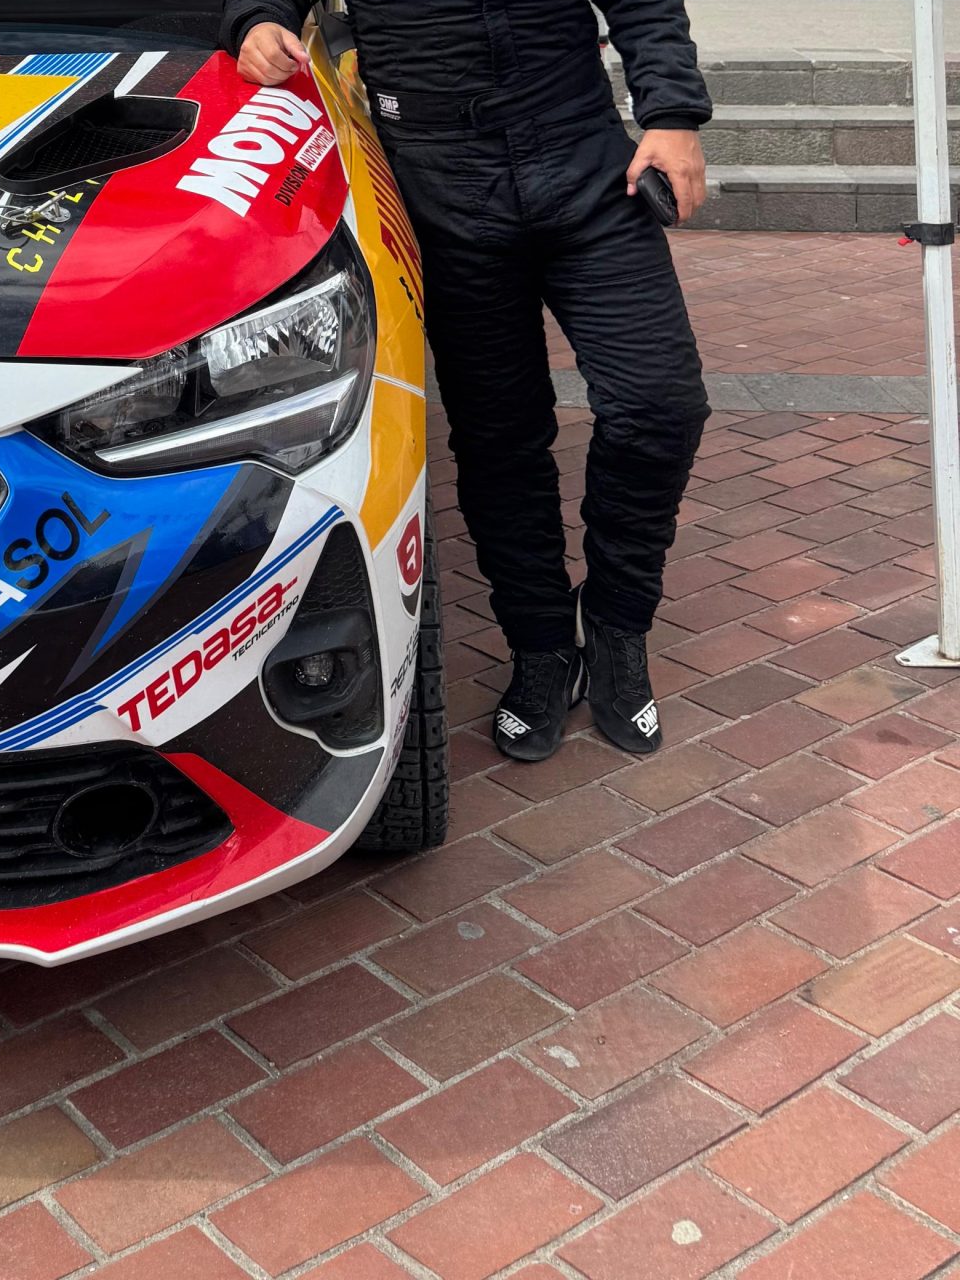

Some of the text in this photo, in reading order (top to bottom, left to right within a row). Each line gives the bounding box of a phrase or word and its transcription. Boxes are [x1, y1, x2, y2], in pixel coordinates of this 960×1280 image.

[378, 97, 400, 111] OMP
[175, 86, 324, 218] MOTUL
[274, 128, 335, 207] DIVISIÓN AUTOMOTRIZ
[496, 711, 528, 737] OMP
[635, 704, 659, 734] OMP
